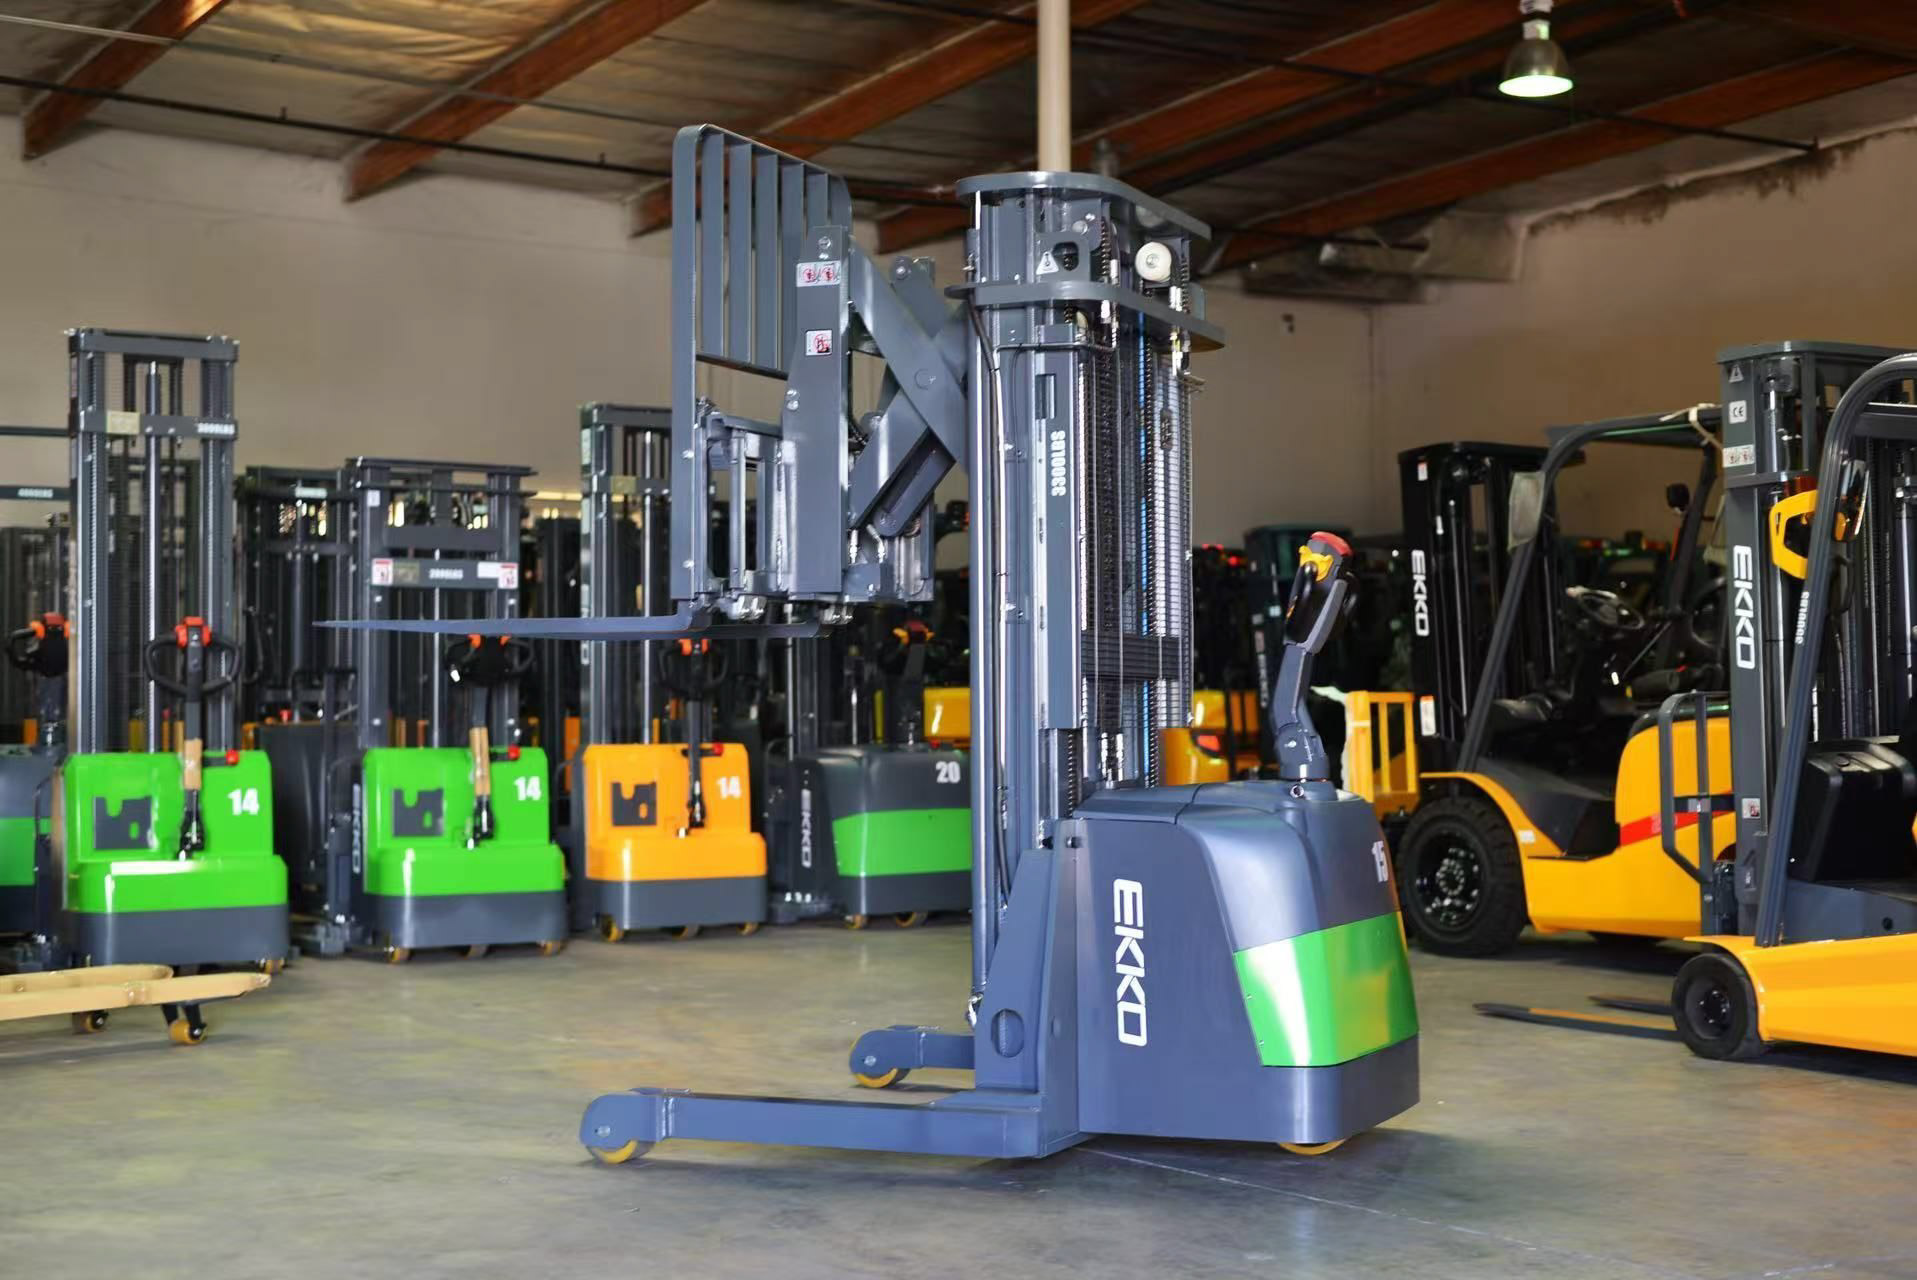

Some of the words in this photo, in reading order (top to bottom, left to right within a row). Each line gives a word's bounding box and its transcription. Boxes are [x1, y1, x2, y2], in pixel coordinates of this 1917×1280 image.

[1733, 406, 1744, 418] CE
[1050, 430, 1066, 496] 3300LBS
[1411, 550, 1430, 636] EKKO
[1733, 545, 1756, 669] EKKO
[514, 776, 542, 801] 14
[716, 776, 742, 799] 14
[935, 761, 961, 783] 20
[227, 788, 260, 816] 14
[801, 788, 812, 868] EKKO
[1113, 878, 1148, 1047] EKKO
